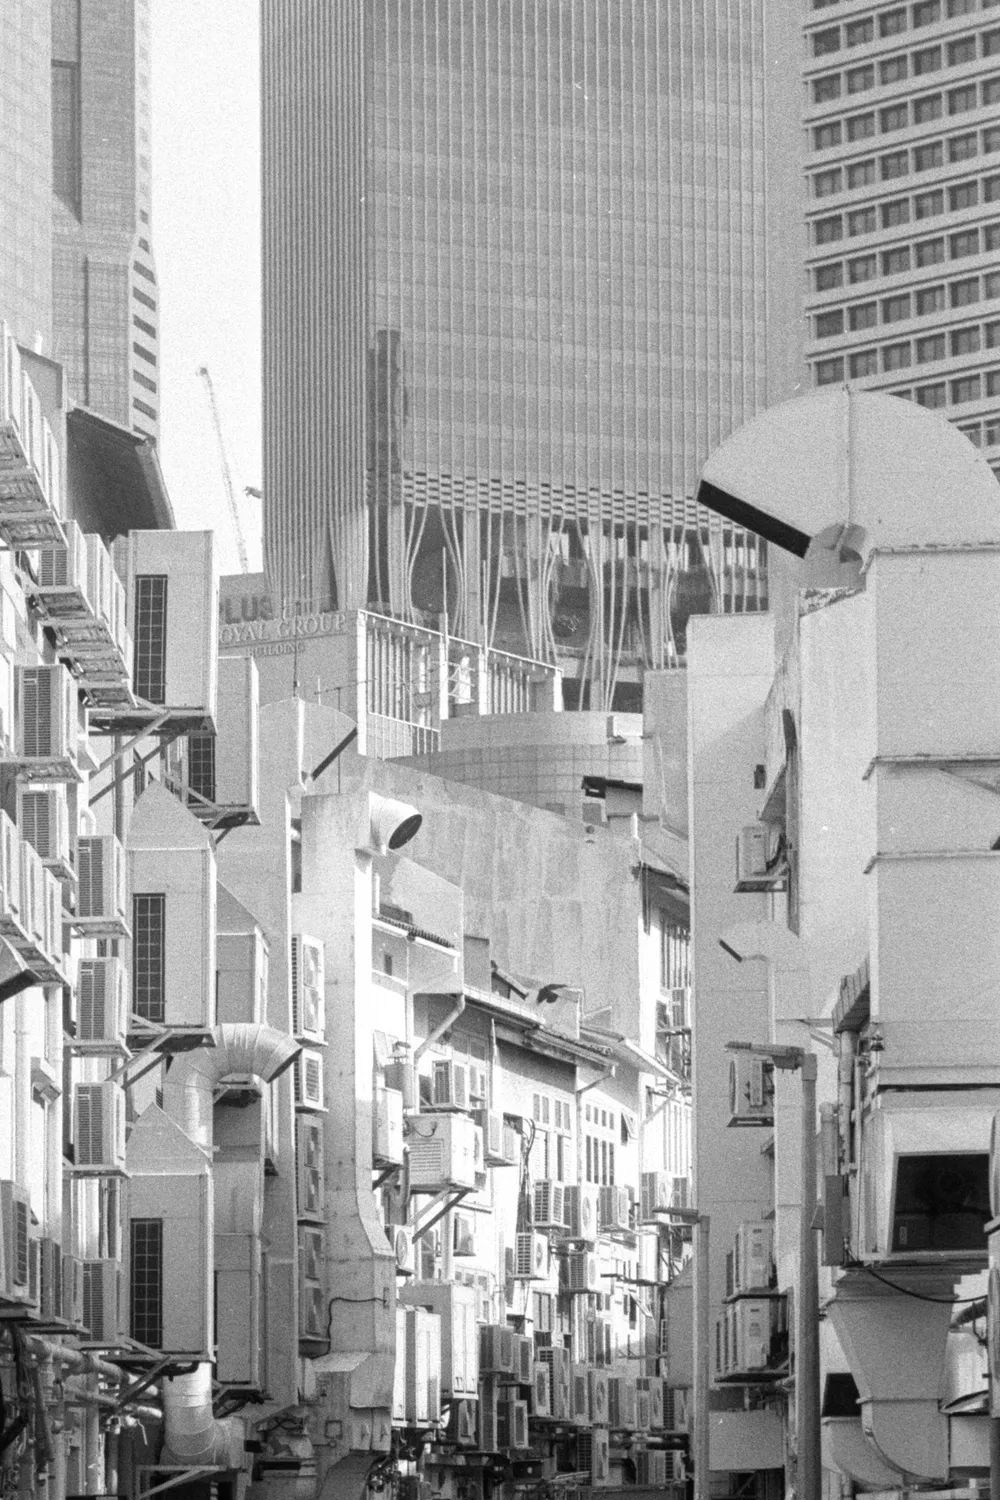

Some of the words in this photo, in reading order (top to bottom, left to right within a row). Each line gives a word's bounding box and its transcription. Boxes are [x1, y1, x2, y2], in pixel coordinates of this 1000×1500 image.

[219, 596, 274, 623] LUS
[219, 623, 269, 643] OYAL
[278, 614, 346, 637] GROUP
[248, 642, 306, 658] BUILDING
